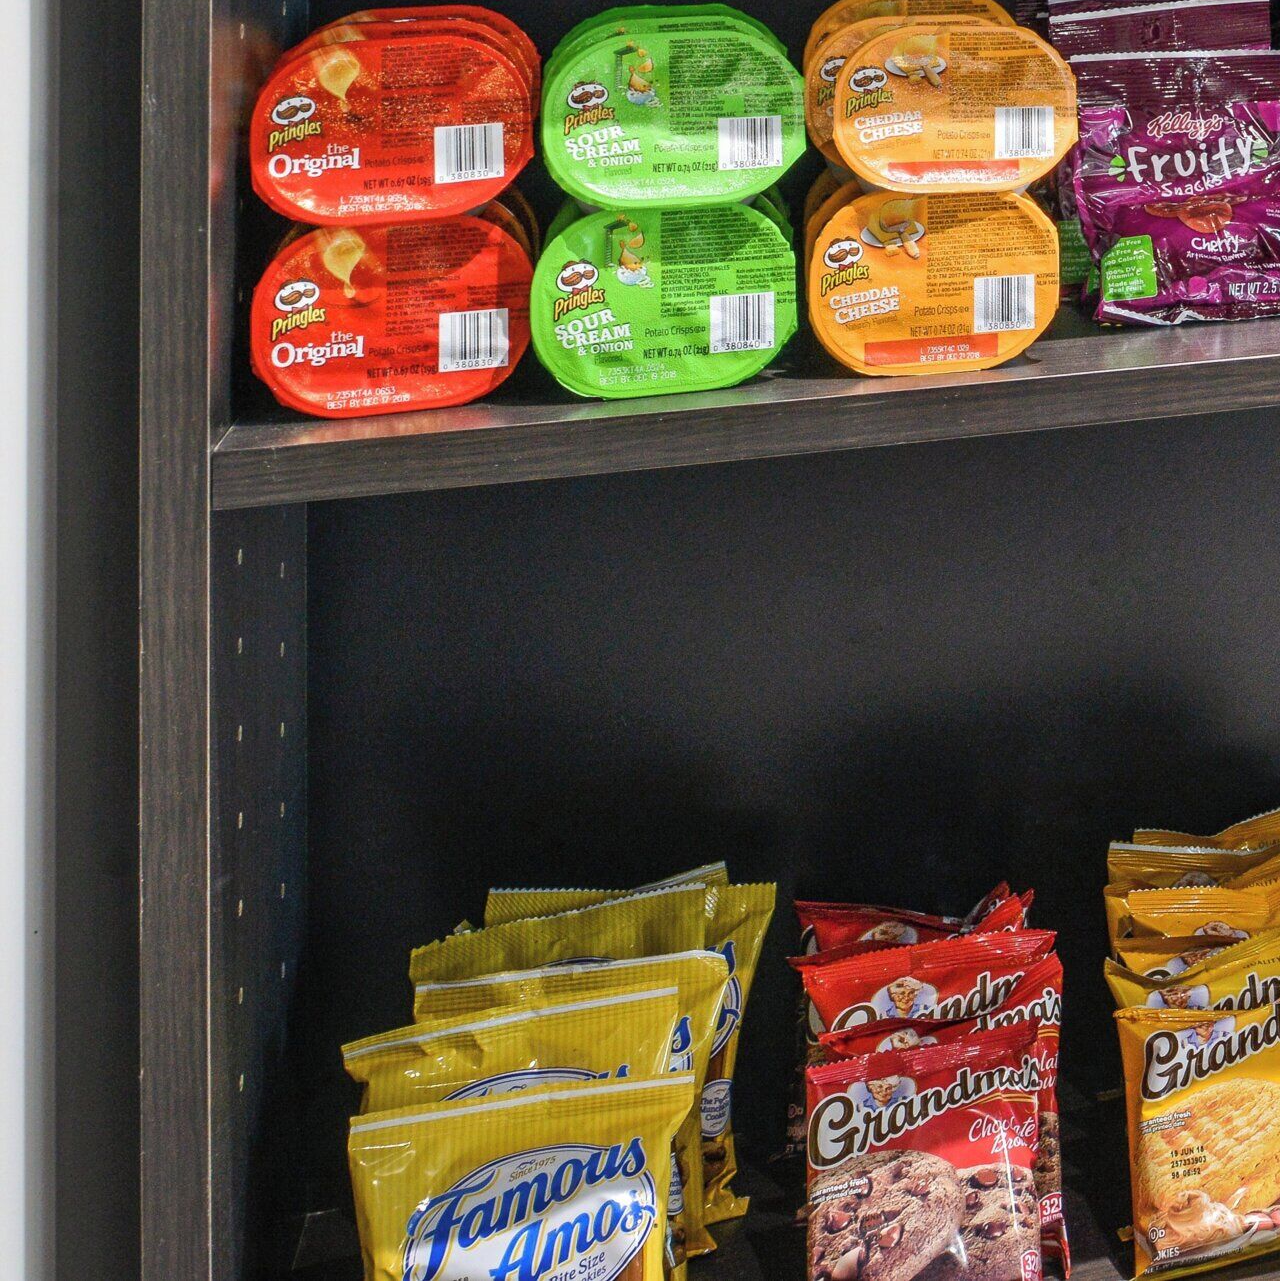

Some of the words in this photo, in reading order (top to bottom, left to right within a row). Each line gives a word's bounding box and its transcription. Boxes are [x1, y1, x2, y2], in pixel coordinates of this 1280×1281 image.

[845, 89, 893, 117] Pringles
[563, 105, 615, 135] Pringles
[853, 110, 922, 131] CHEDDAR
[1146, 112, 1223, 139] Kellogg's
[268, 119, 322, 153] Pringles
[564, 126, 626, 150] SOUR
[859, 122, 924, 144] CHEESE
[268, 146, 361, 178] Original
[570, 139, 640, 160] CREAM
[600, 153, 642, 168] ONION
[1160, 176, 1222, 198] Snacks
[1191, 234, 1239, 252] Cherry
[821, 264, 870, 296] Pringles
[553, 288, 605, 320] Pringles
[828, 285, 901, 309] CHEDDAR
[271, 304, 326, 340] Pringles
[554, 308, 616, 336] SOUR
[835, 300, 901, 324] CHEESE
[561, 324, 631, 349] CREAM
[590, 340, 634, 354] ONION
[270, 334, 364, 369] Original
[643, 349, 657, 359] NET
[657, 349, 668, 357] WT
[668, 348, 681, 358] 0.74
[683, 346, 693, 355] OZ
[455, 360, 493, 369] 380830
[808, 1056, 1040, 1171] Grandma's
[1180, 1147, 1196, 1156] JUN
[509, 1166, 534, 1183] Since
[532, 1155, 556, 1171] 1975
[403, 1137, 647, 1281] Famous
[489, 1189, 657, 1281] Amos
[579, 1250, 605, 1271] Size
